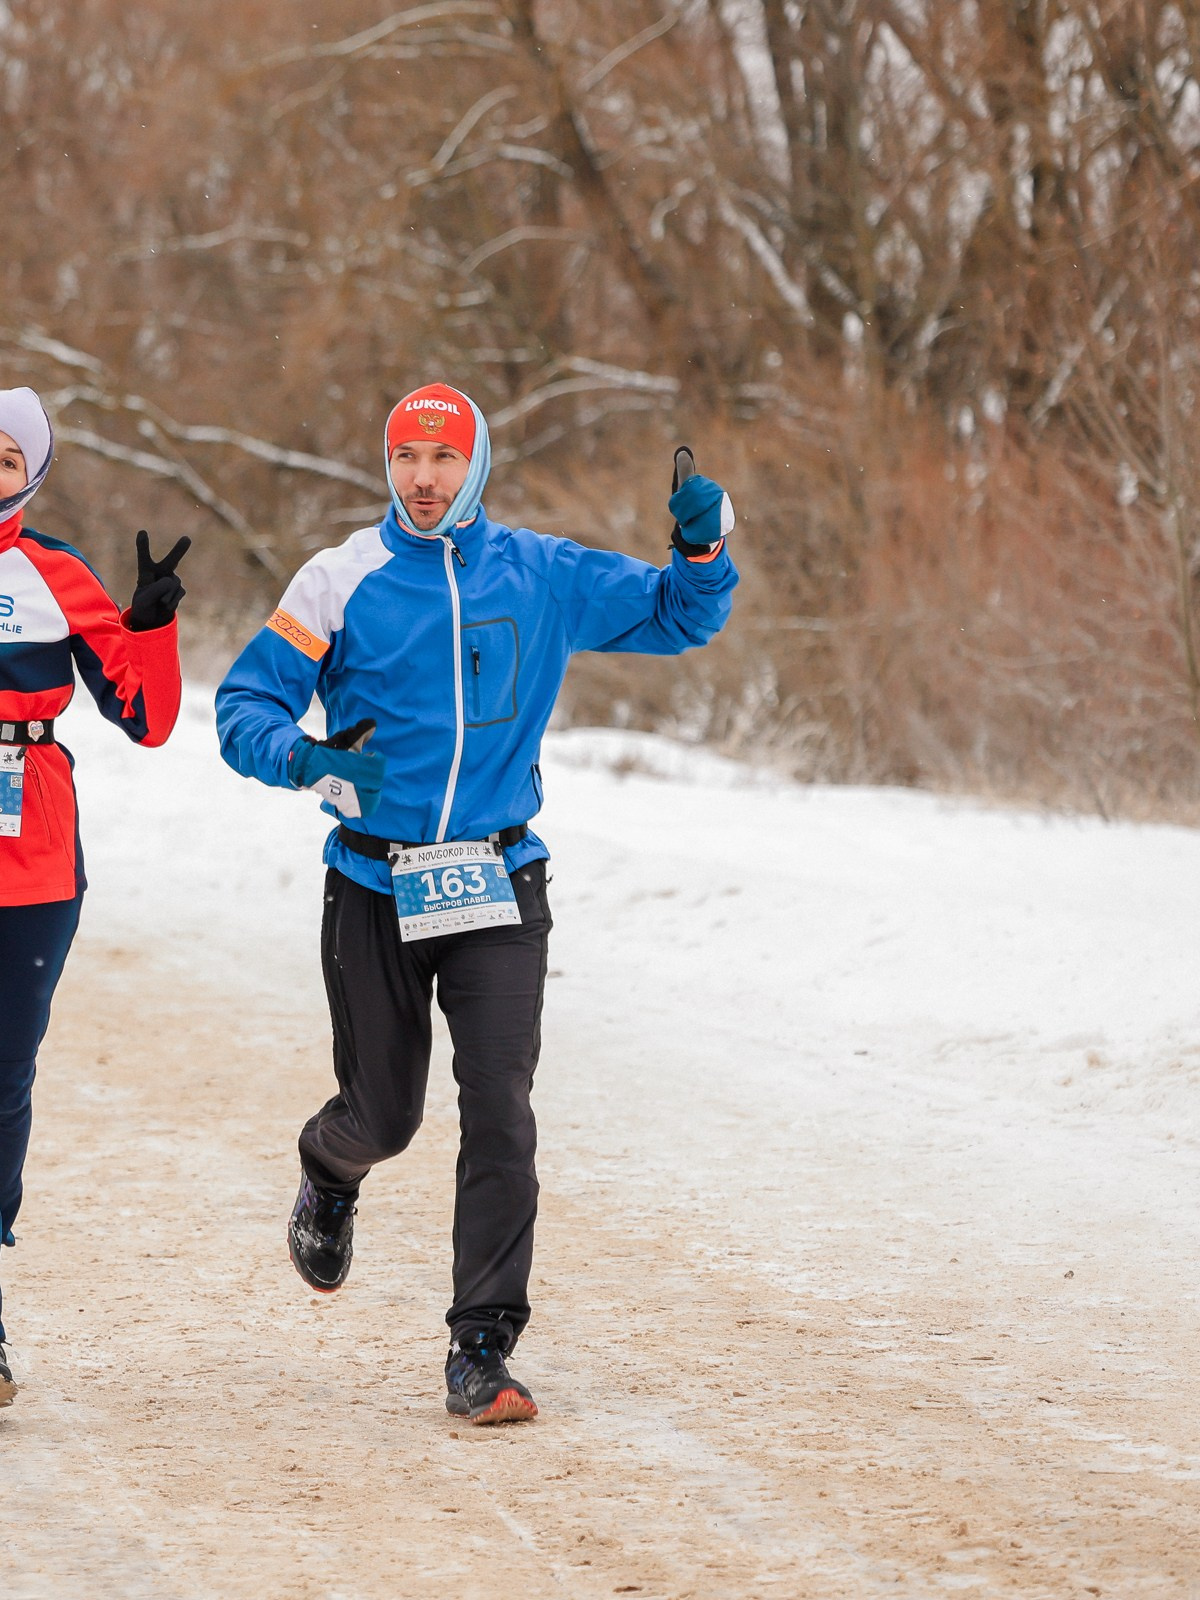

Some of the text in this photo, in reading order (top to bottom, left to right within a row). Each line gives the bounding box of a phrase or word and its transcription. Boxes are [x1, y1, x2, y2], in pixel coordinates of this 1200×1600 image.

[405, 399, 461, 416] LUKOIL
[418, 846, 480, 863] NOVGOROD ICE
[420, 865, 487, 902] 163
[423, 899, 462, 912] БЫСТРОВ
[464, 895, 492, 905] ПАВЕЛ
